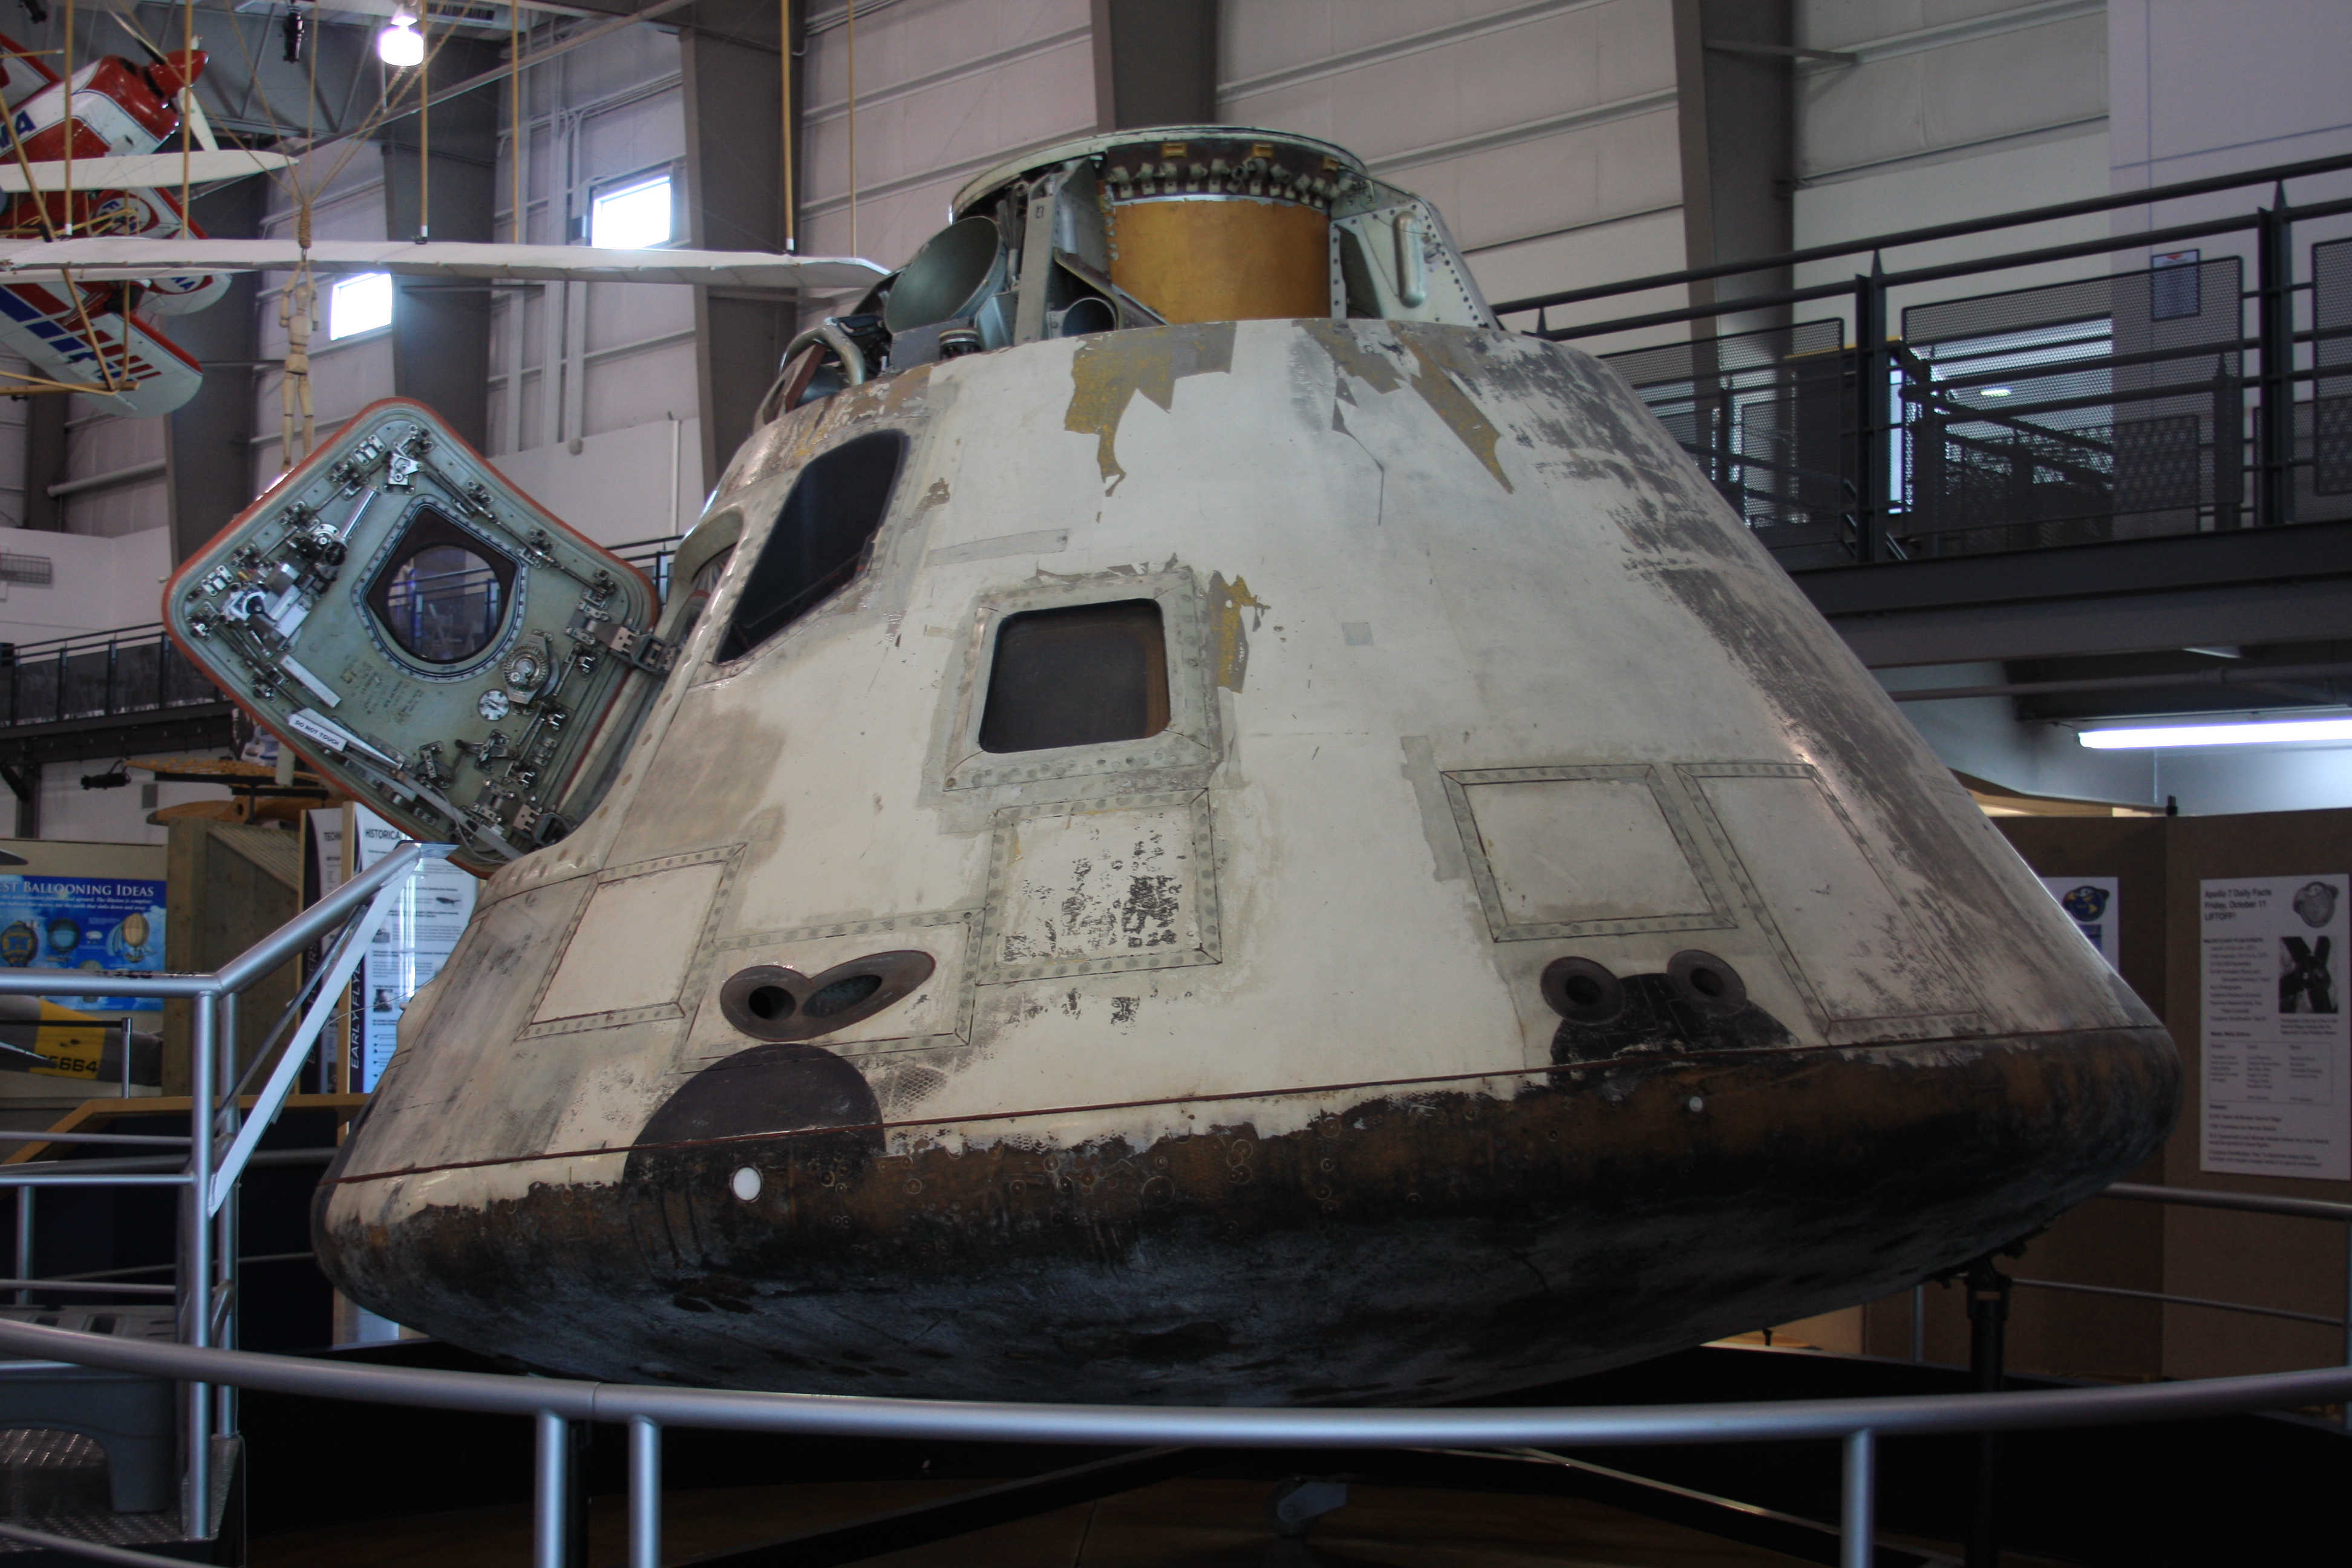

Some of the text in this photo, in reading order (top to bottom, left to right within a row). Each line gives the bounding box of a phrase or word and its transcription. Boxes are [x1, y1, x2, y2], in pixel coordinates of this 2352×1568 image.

[305, 724, 318, 735] NOT
[319, 733, 340, 746] TOUCH
[24, 881, 112, 896] BALLOONING
[116, 884, 154, 897] IDEAS
[2204, 890, 2226, 900] Apollo
[2233, 889, 2250, 898] Daily
[2252, 888, 2272, 897] Facts
[2229, 900, 2256, 909] October
[351, 1011, 359, 1069] EARLY
